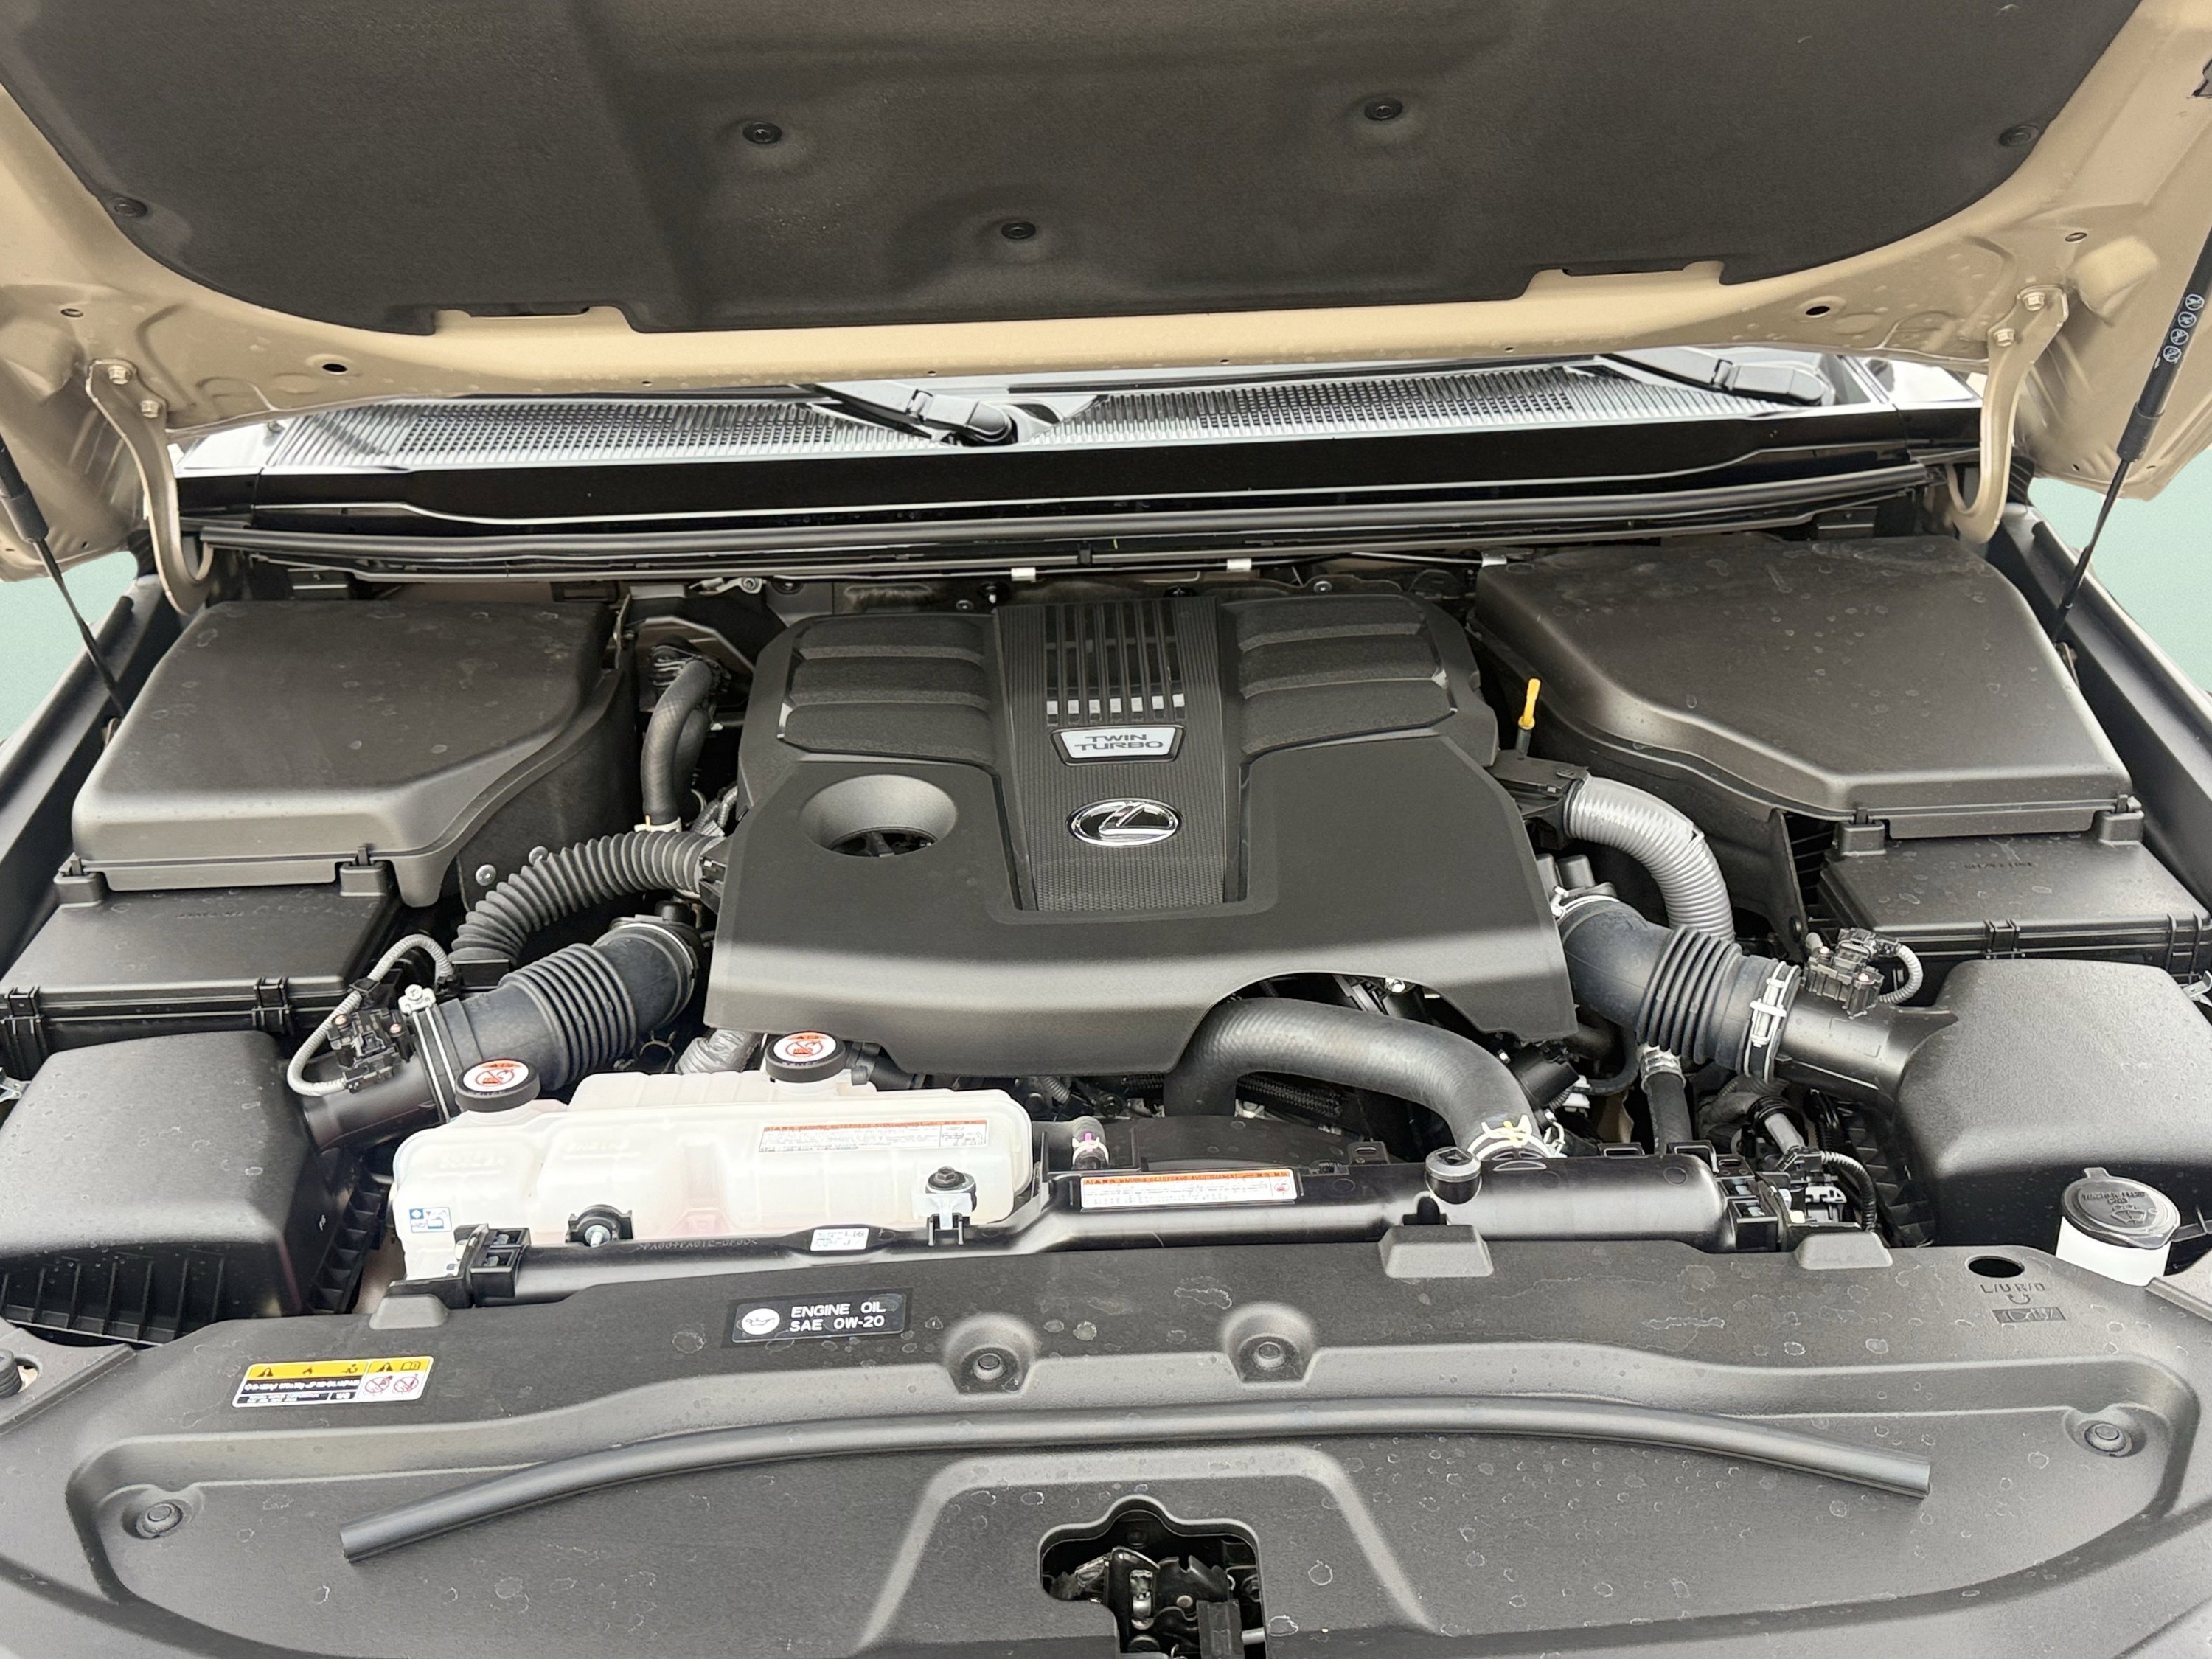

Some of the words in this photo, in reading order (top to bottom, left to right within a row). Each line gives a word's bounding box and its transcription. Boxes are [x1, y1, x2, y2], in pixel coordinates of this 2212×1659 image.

[1085, 734, 1147, 742] TWIN
[1074, 741, 1164, 751] TURBO
[790, 1303, 851, 1318] ENGINE
[860, 1301, 886, 1314] OIL
[789, 1318, 824, 1332] SAE
[833, 1315, 886, 1329] 0W-20
